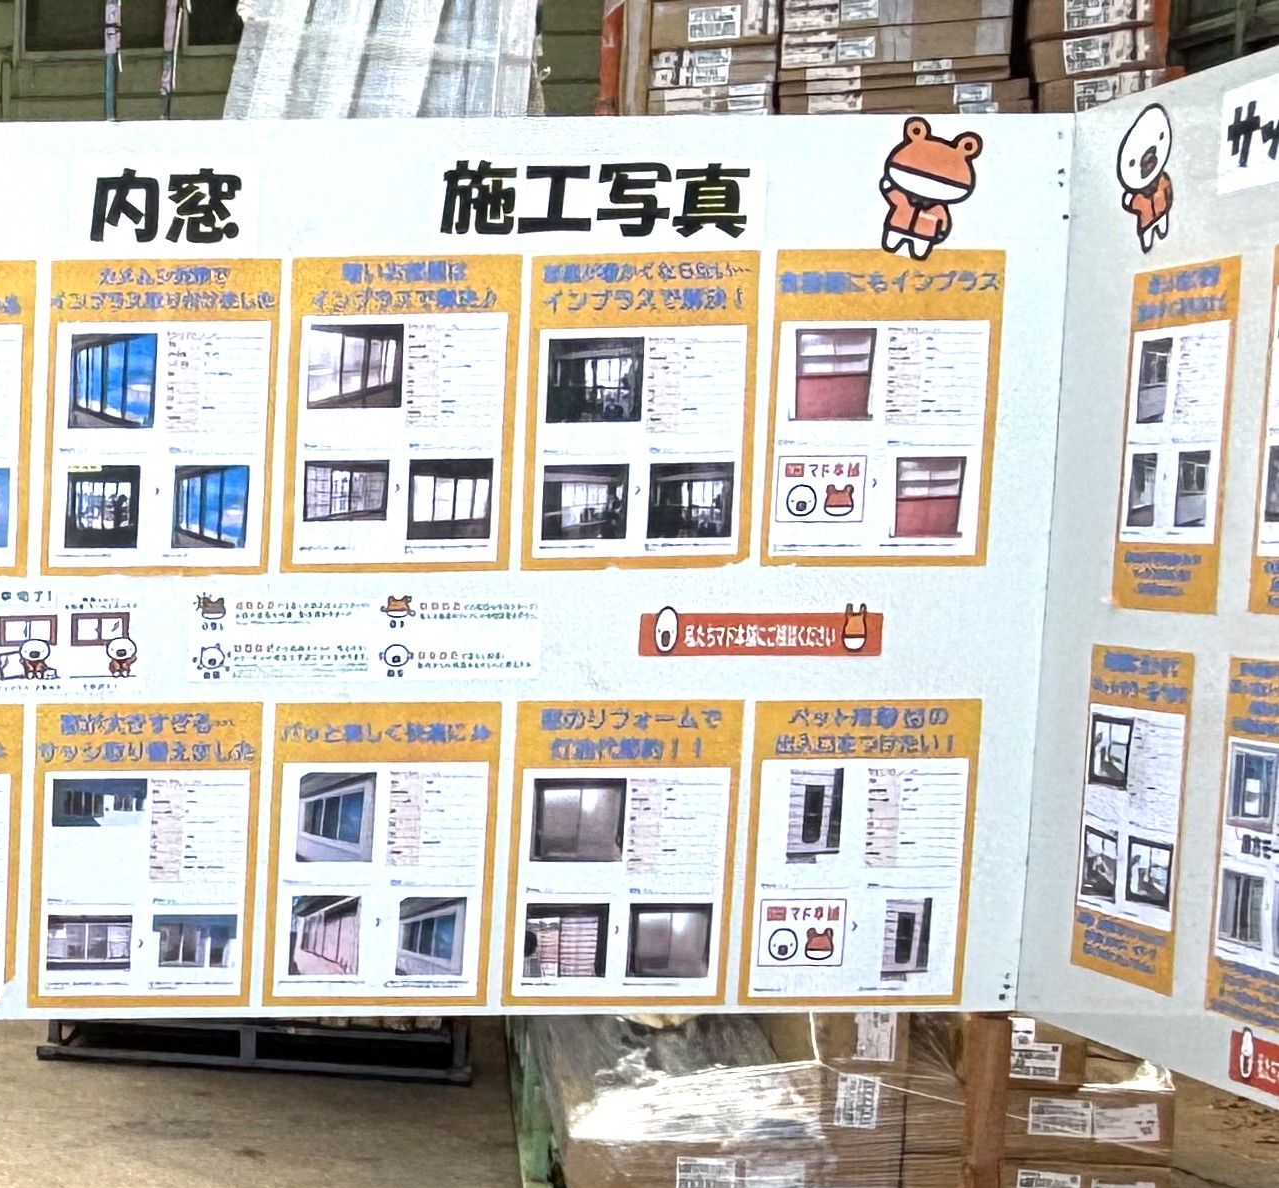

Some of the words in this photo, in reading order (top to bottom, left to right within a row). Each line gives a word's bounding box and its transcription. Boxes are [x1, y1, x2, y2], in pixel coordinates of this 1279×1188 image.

[90, 168, 242, 243] 内窓
[440, 160, 750, 238] 施工写真
